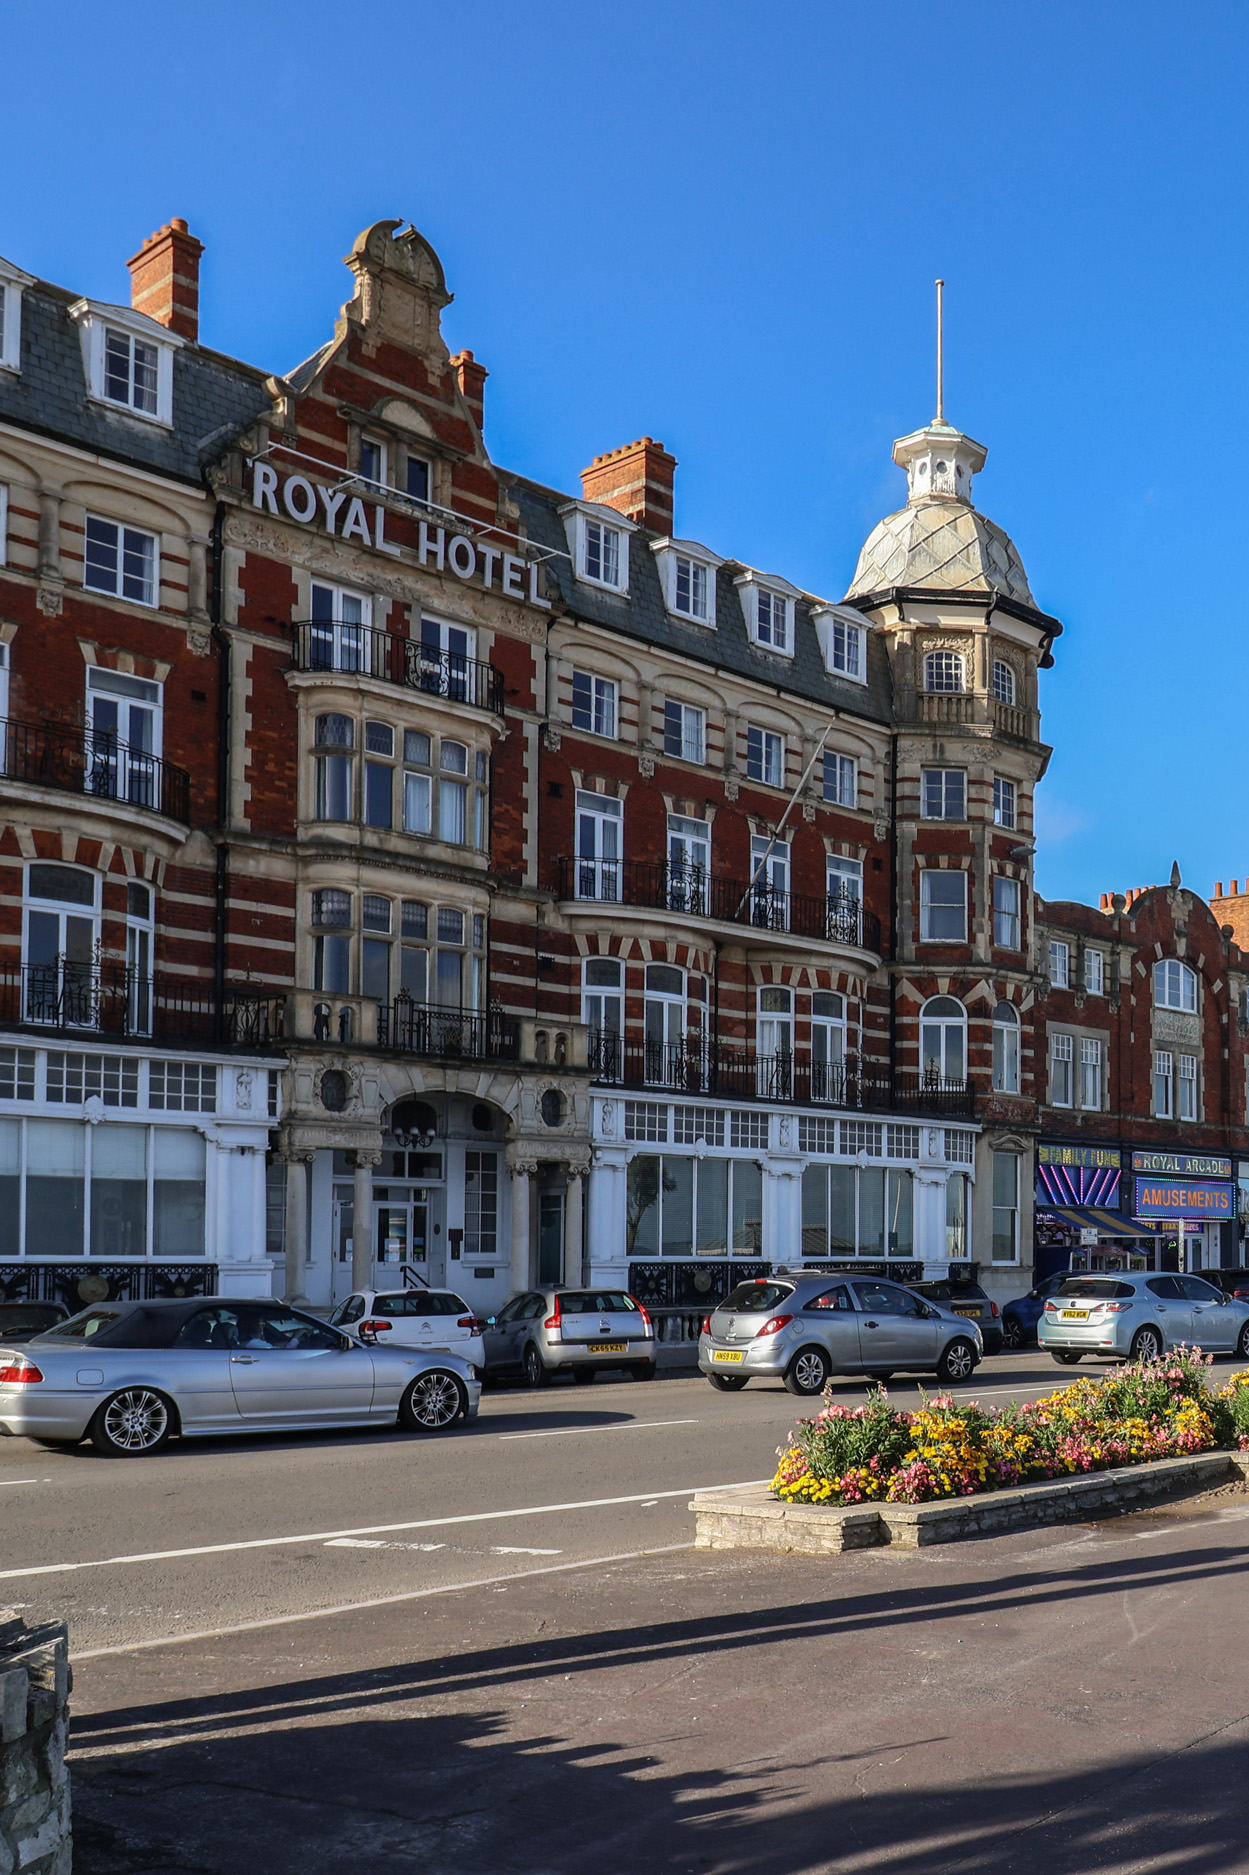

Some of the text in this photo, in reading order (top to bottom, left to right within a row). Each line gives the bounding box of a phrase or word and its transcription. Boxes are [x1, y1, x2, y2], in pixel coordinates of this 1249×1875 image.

[252, 460, 551, 609] ROYAL HOTEL
[1049, 1147, 1111, 1166] FAMILY FUN
[1143, 1154, 1224, 1174] ROYAL ARCADE
[1142, 1188, 1229, 1208] AMUSEMENTS
